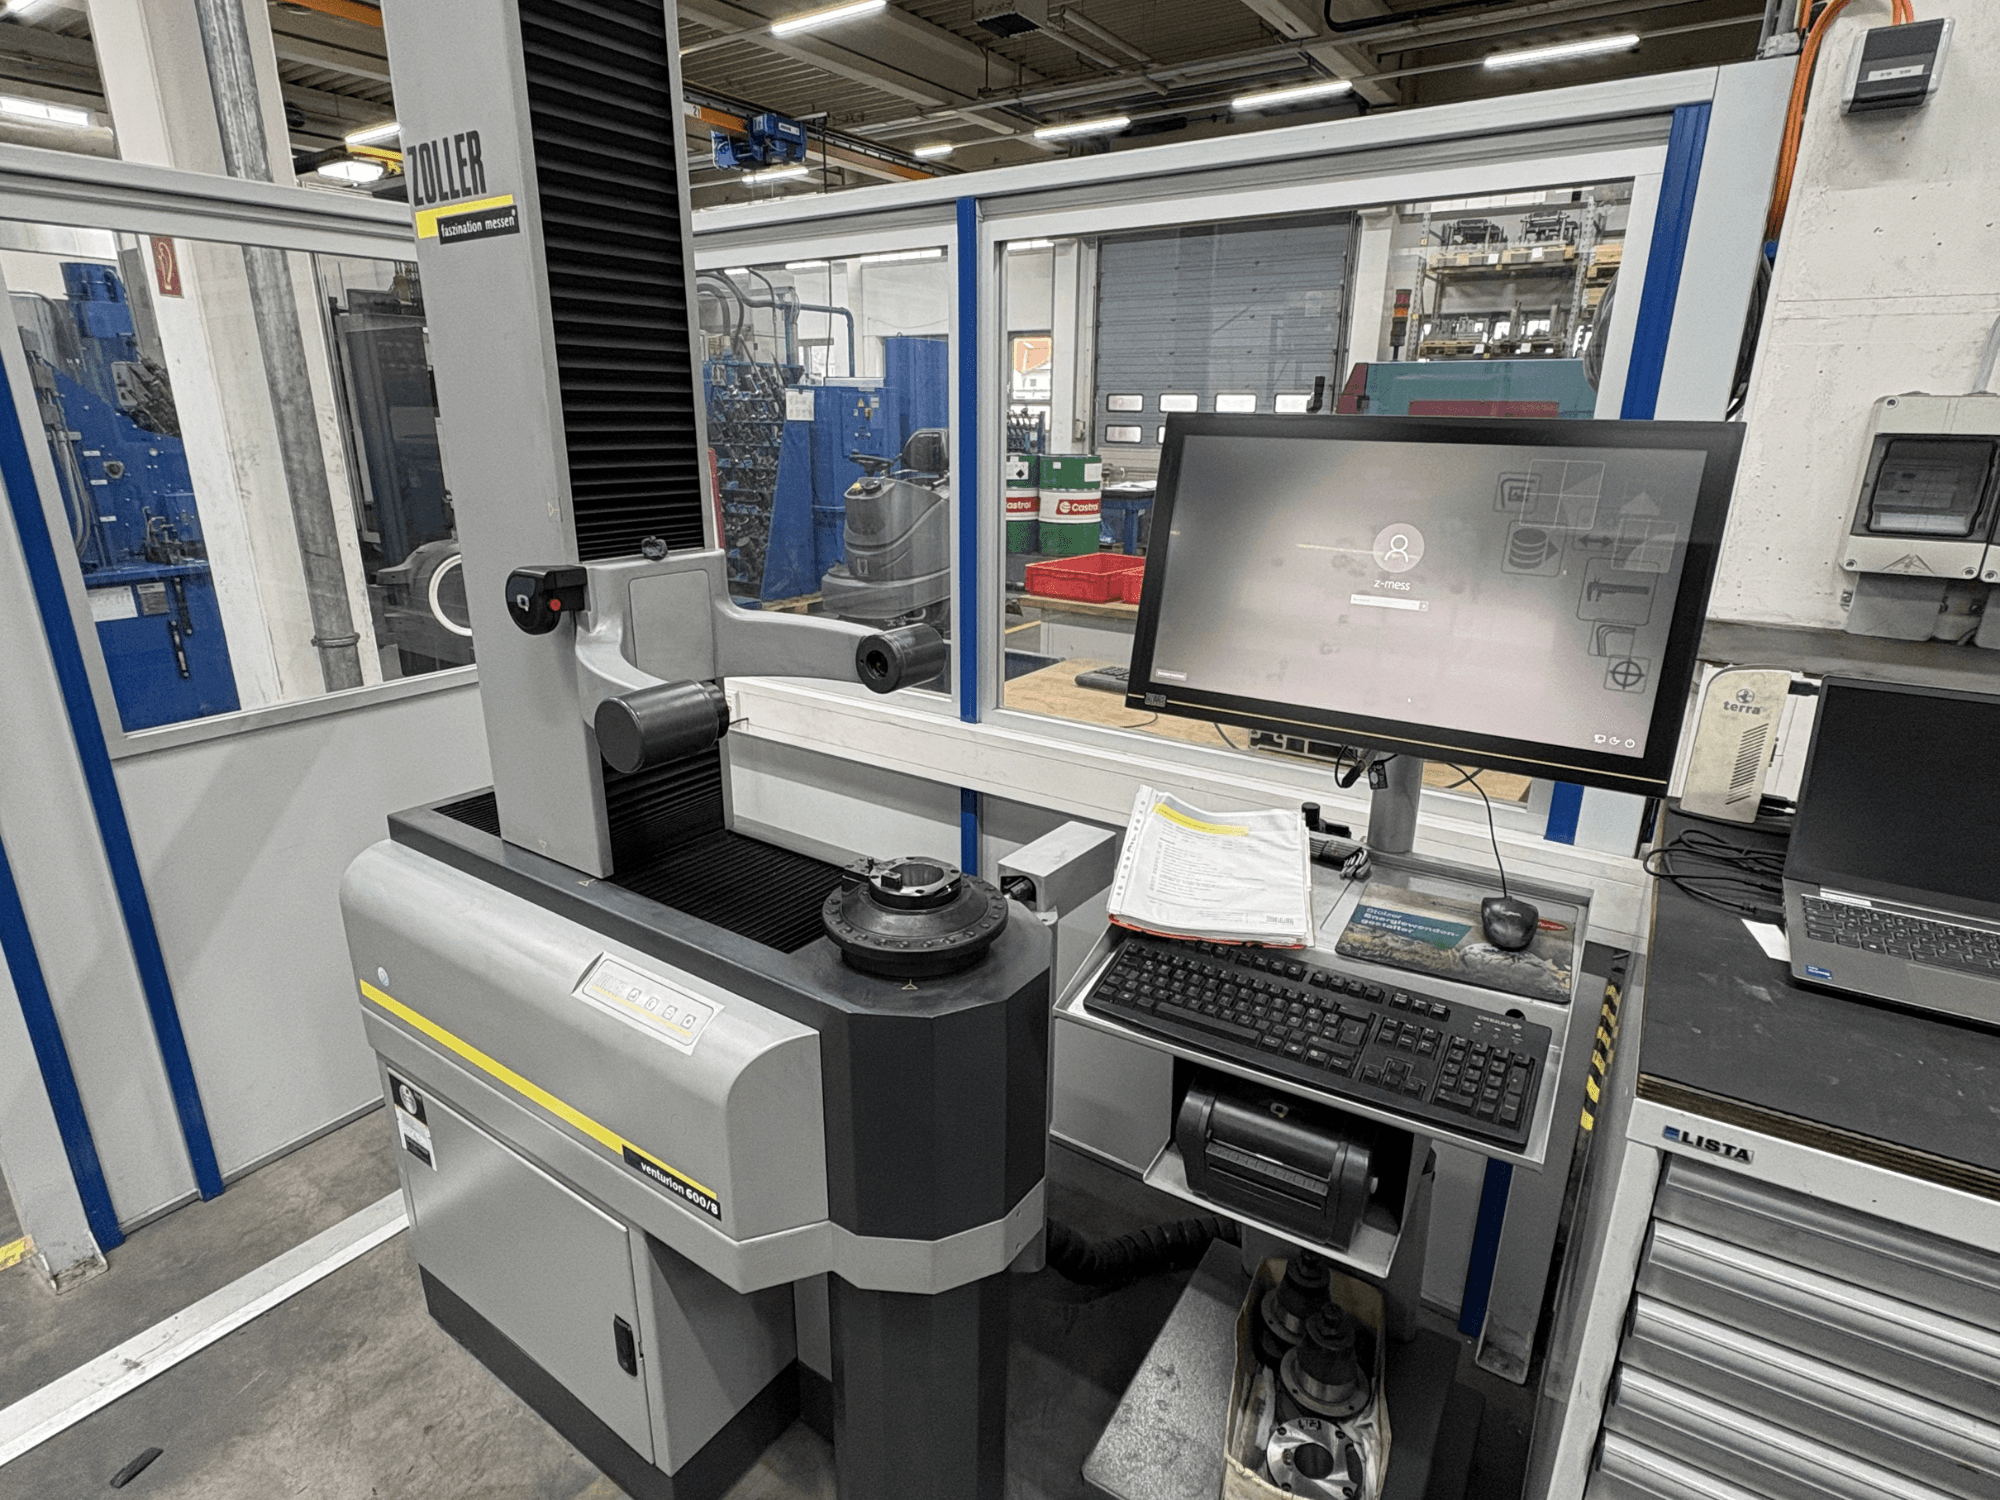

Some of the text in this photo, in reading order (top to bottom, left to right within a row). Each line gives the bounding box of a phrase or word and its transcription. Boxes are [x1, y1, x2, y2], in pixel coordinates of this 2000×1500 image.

[406, 130, 487, 207] ZOLLER
[441, 220, 482, 237] faszination
[1006, 501, 1031, 510] astrol
[1373, 580, 1411, 591] z-mess
[1723, 701, 1761, 715] terra
[1366, 907, 1402, 919] Stolzer
[1360, 919, 1415, 934] gestalter
[1363, 912, 1460, 937] Energiewenden-
[1681, 1131, 1750, 1162] LISTA
[640, 1162, 719, 1215] venturion 600/8
